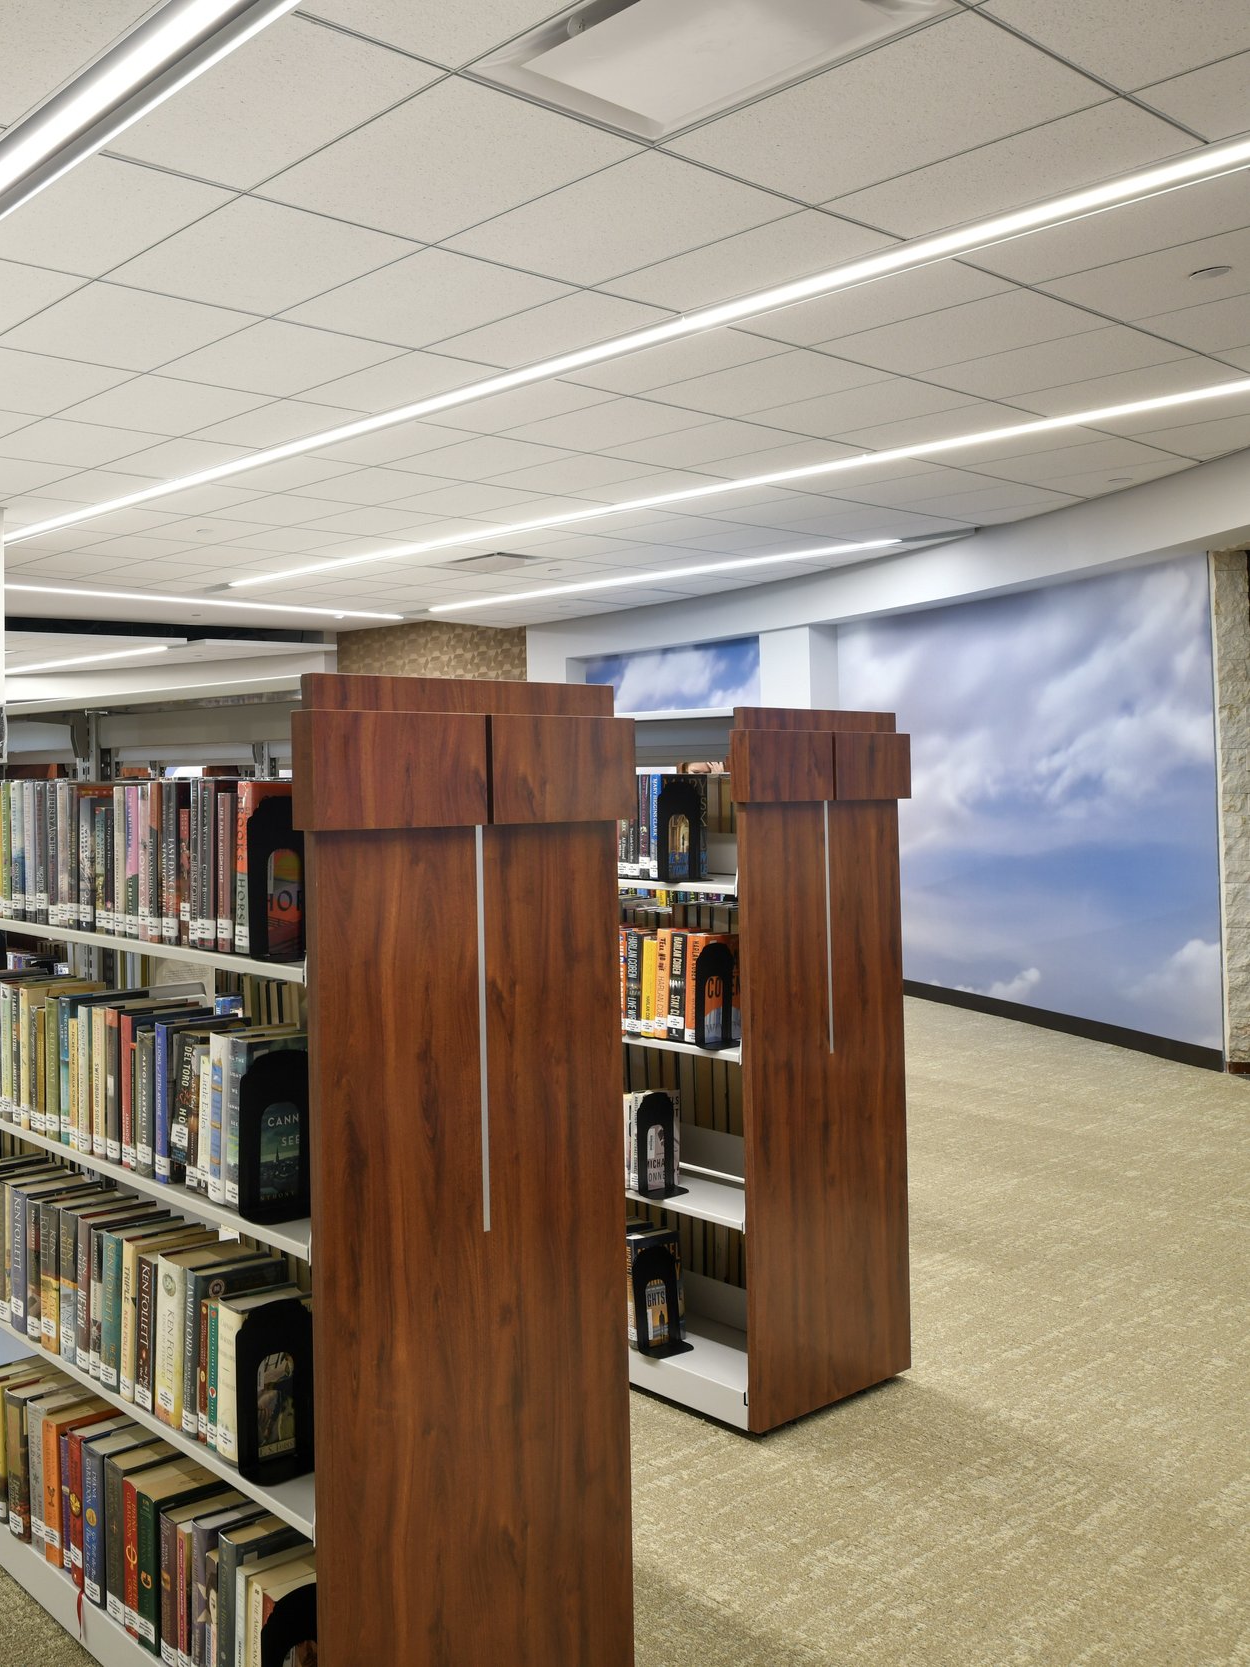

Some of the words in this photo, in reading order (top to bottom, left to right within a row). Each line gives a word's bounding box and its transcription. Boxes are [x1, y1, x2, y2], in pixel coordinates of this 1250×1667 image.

[48, 825, 56, 855] ARCHER
[237, 796, 245, 861] BROOKS
[628, 936, 637, 957] HARLAN
[673, 936, 683, 957] HARLAN
[628, 958, 638, 978] COBEN
[672, 958, 682, 975] COBEN
[184, 1046, 192, 1063] DEL
[182, 1065, 191, 1087] TORO
[14, 1223, 22, 1270] FOLLETT
[40, 1215, 49, 1264] FOLLETT
[106, 1242, 116, 1268] KEN
[142, 1264, 150, 1290] KEN
[104, 1271, 114, 1322] FOLLETT
[140, 1292, 150, 1350] FOLLETT
[166, 1340, 174, 1394] FOLLETT
